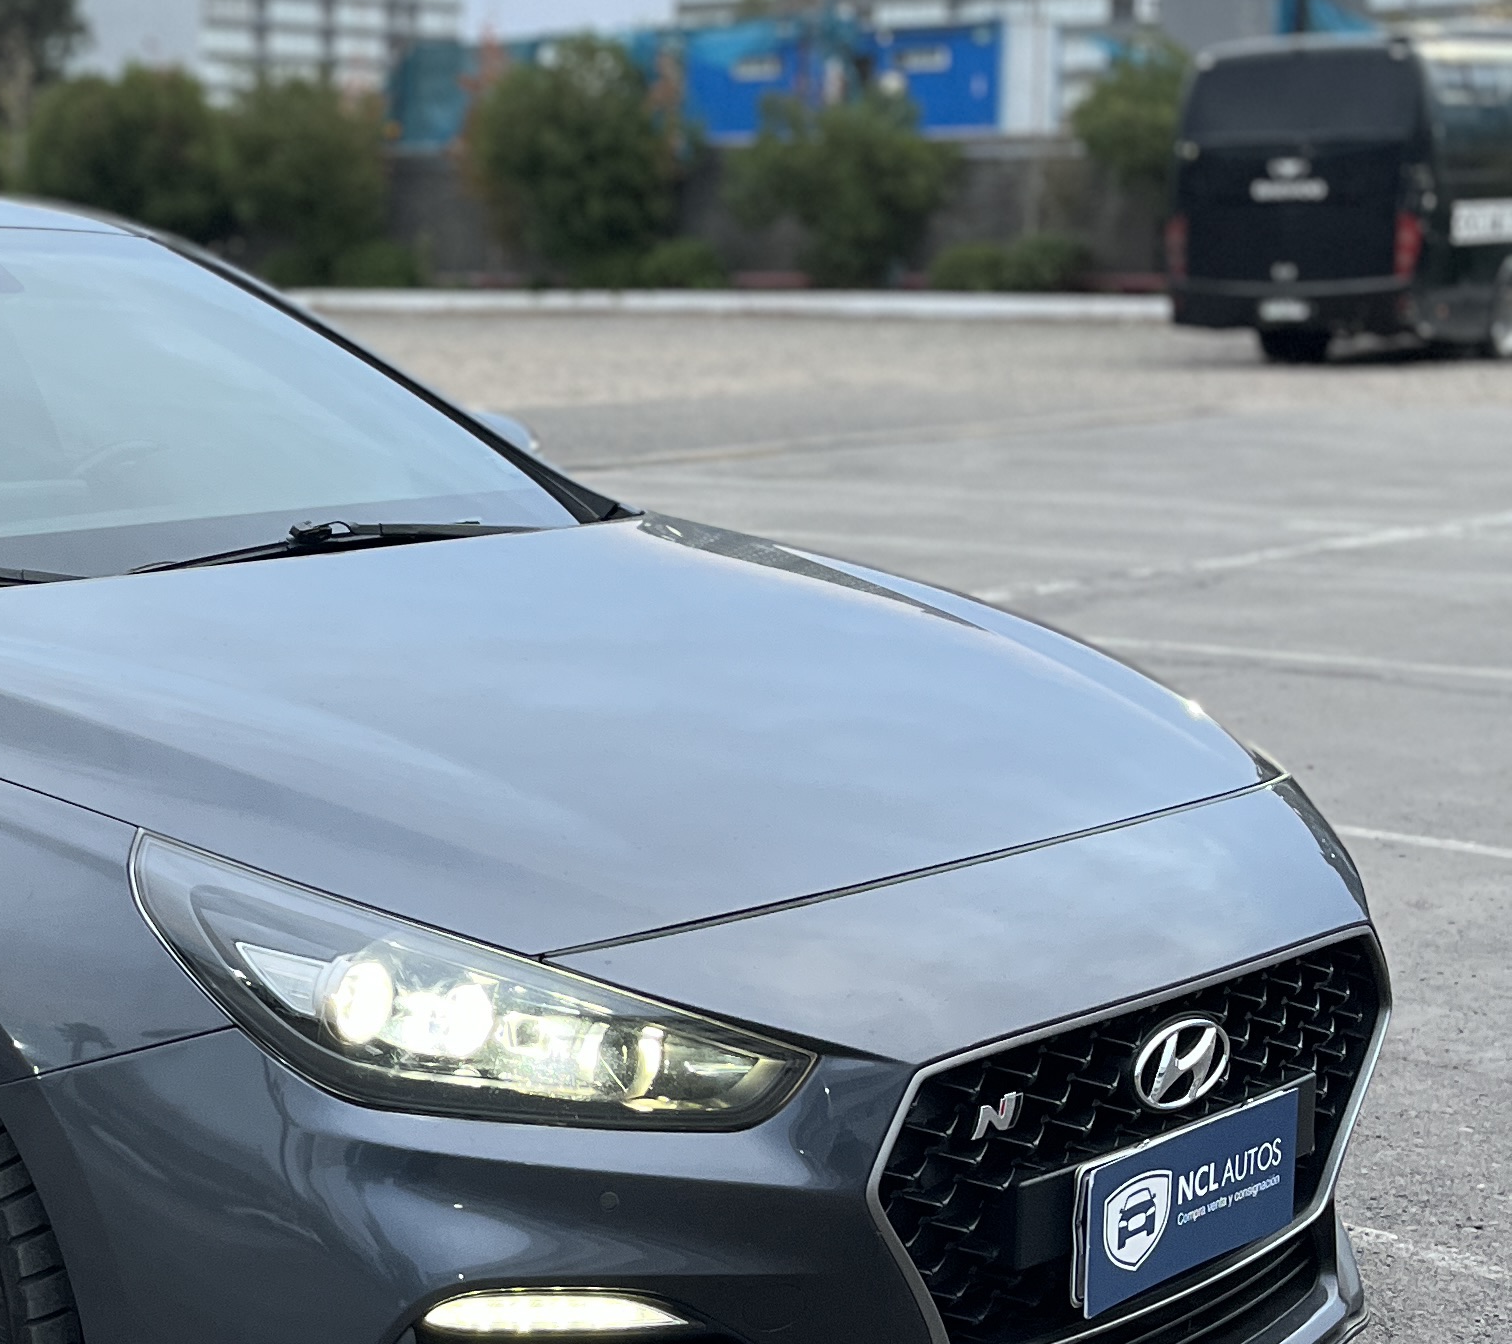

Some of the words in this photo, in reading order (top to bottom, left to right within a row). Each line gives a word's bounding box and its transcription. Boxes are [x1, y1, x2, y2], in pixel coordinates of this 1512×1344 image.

[1177, 1206, 1206, 1225] Compra
[1207, 1196, 1227, 1213] venta
[1227, 1194, 1234, 1207] y
[1234, 1174, 1280, 1201] consignación
[1178, 1163, 1219, 1205] NCL
[1221, 1138, 1282, 1187] AUTOS
